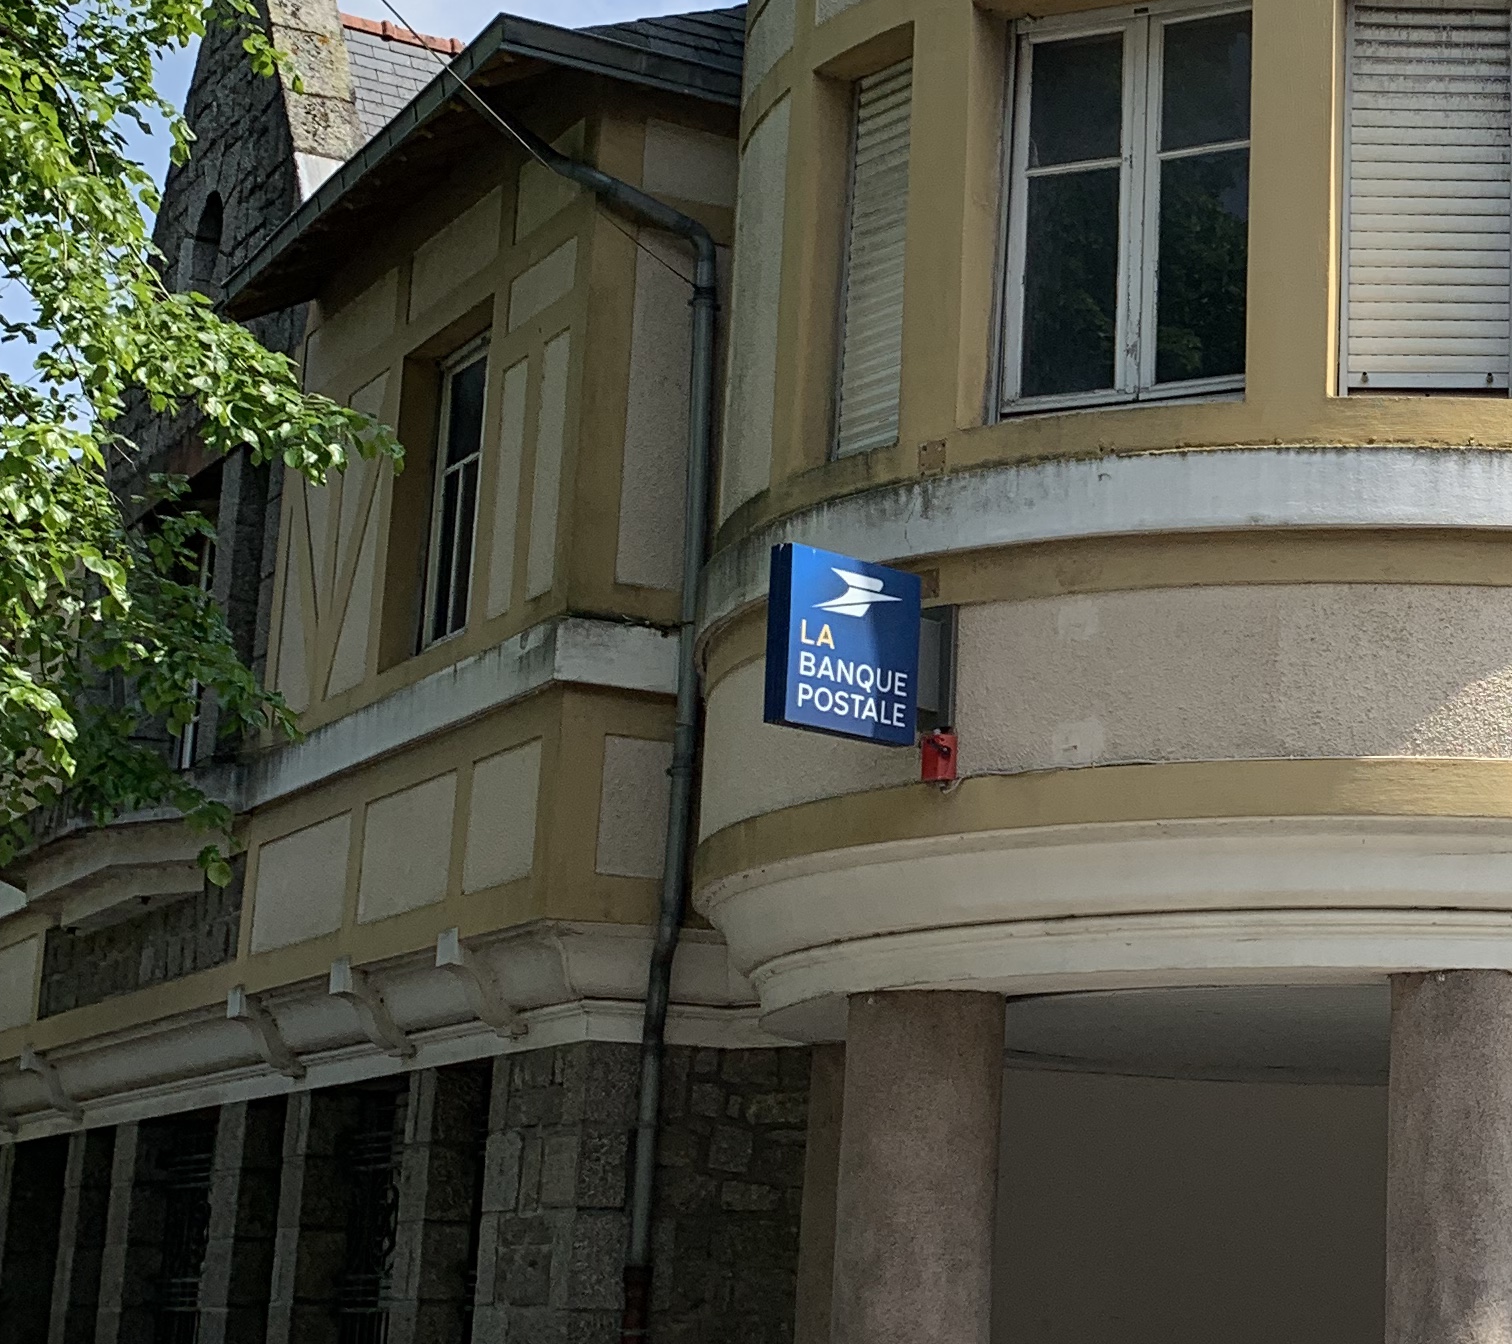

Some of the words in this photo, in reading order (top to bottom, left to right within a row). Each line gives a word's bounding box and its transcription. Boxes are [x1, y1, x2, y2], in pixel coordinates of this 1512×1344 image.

[800, 618, 835, 650] LA
[799, 650, 908, 697] BANQUE
[797, 682, 906, 728] POSTALE
